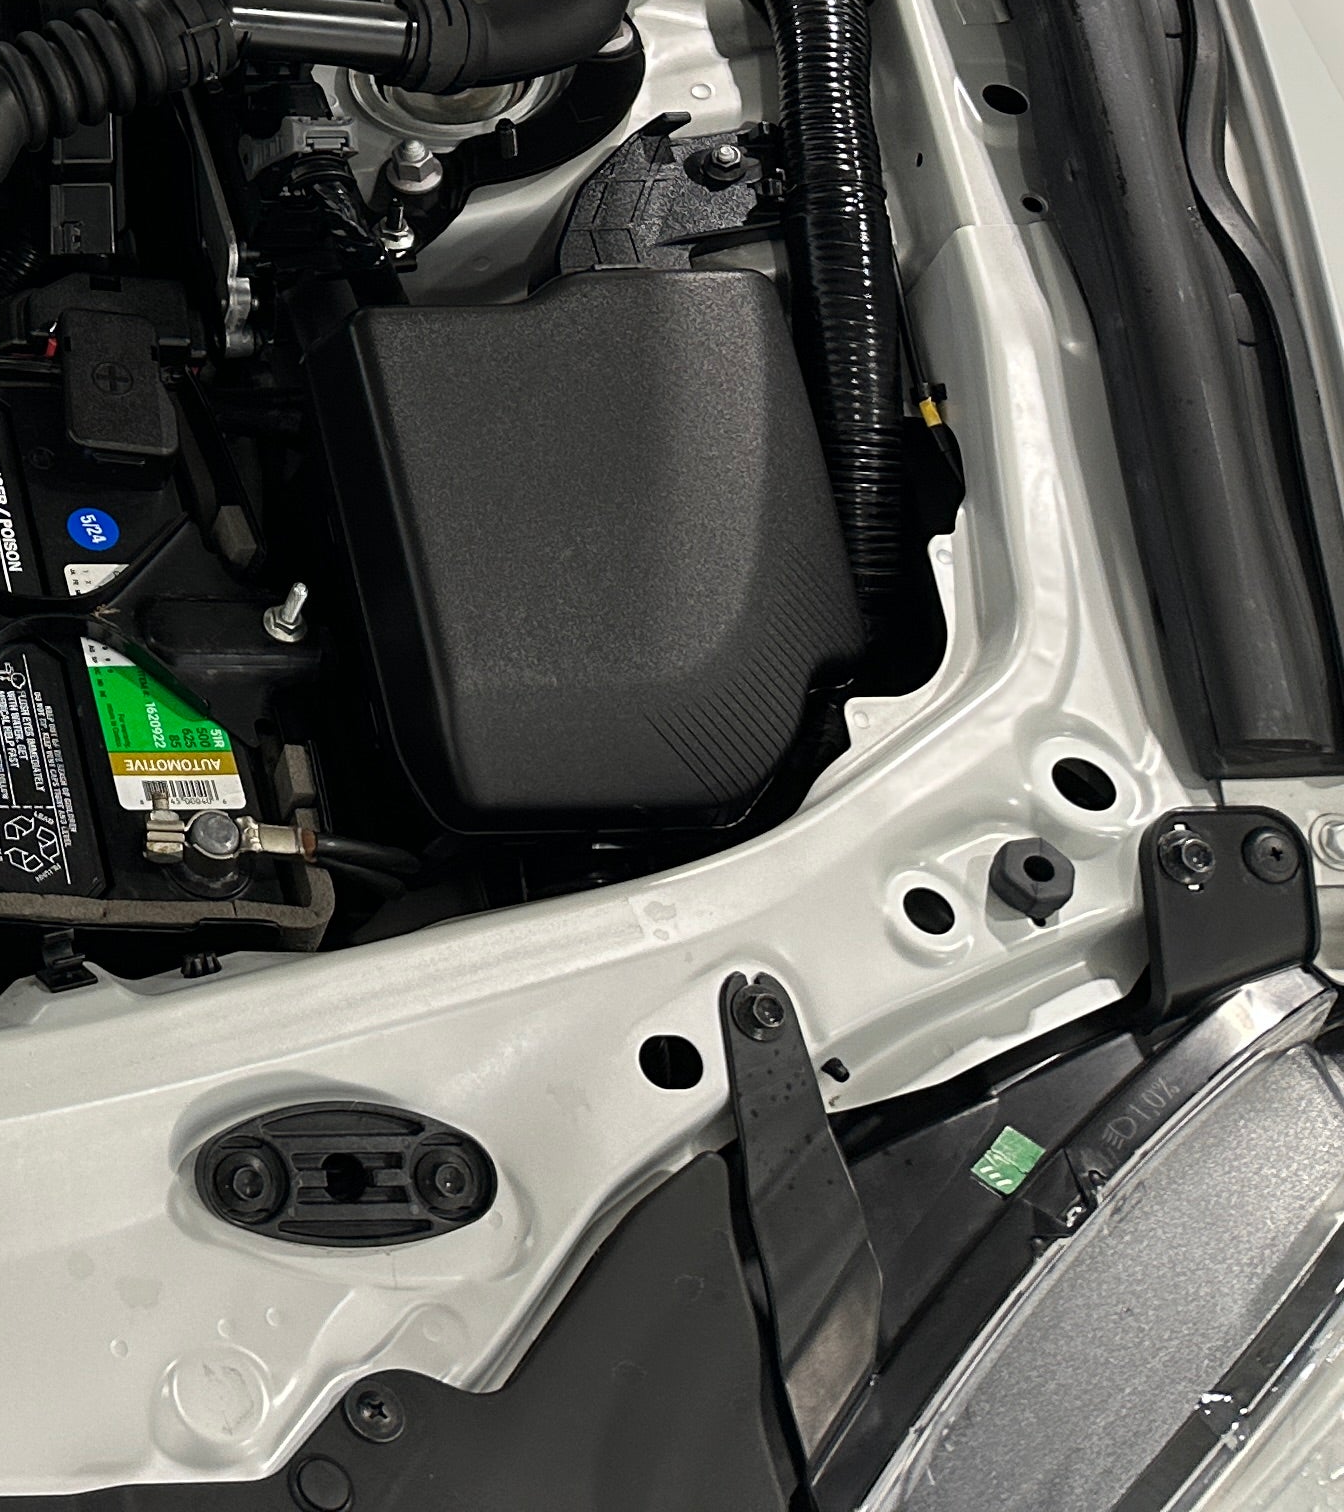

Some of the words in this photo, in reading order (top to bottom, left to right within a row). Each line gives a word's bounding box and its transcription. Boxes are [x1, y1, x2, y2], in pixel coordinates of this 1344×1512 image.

[80, 514, 107, 543] 5/24
[145, 703, 166, 748] 1620922
[168, 735, 181, 748] 85
[182, 729, 196, 748] 625
[196, 728, 211, 748] 500
[210, 729, 224, 748] 51R
[124, 759, 220, 771] AUTOMOTIVE
